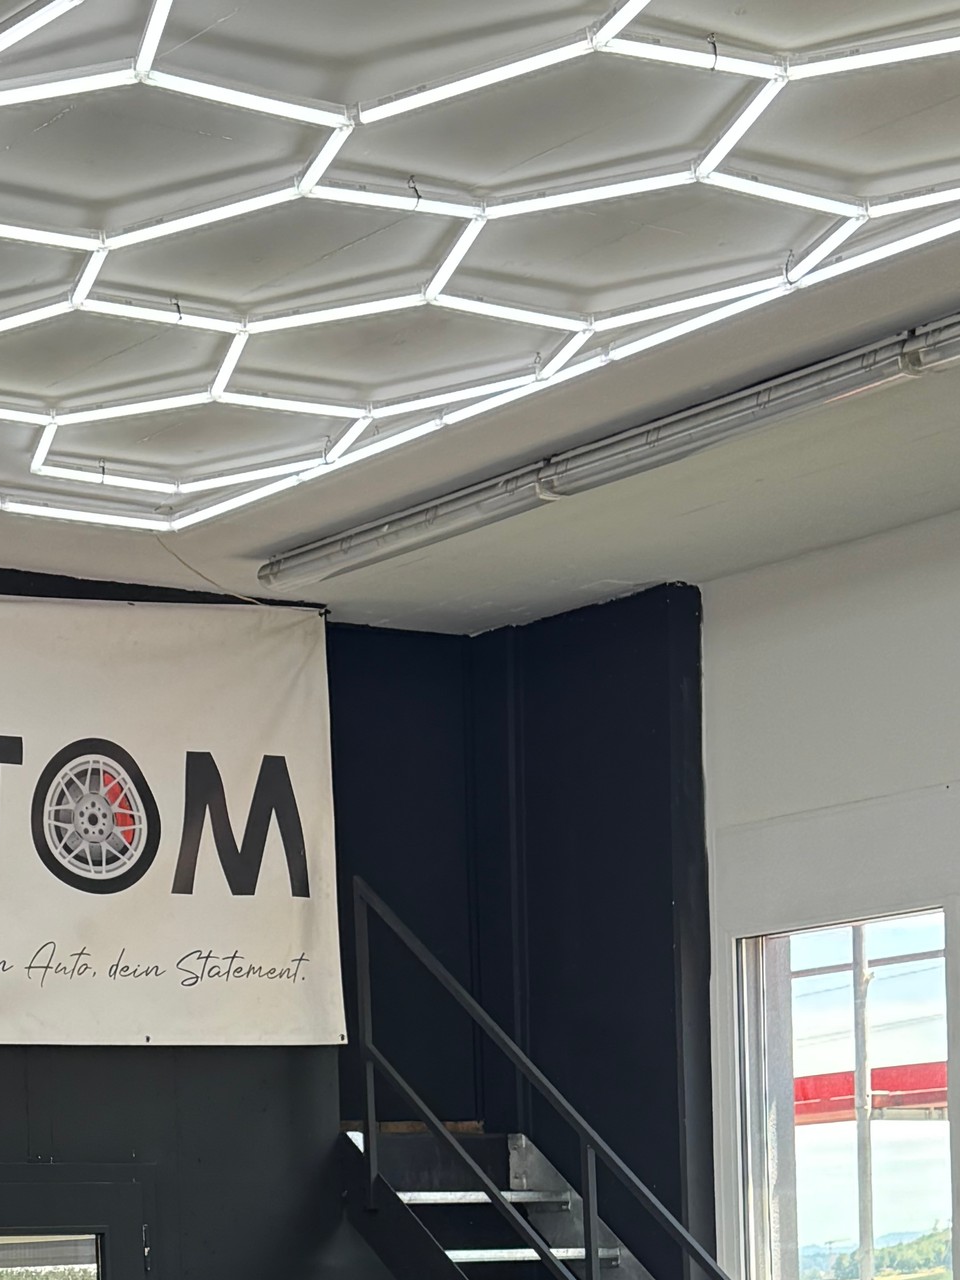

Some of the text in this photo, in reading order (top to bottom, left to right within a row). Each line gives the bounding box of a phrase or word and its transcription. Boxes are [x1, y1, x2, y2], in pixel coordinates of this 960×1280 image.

[24, 942, 98, 988] Auto,
[107, 946, 166, 979] dein
[175, 949, 311, 987] Statement.
